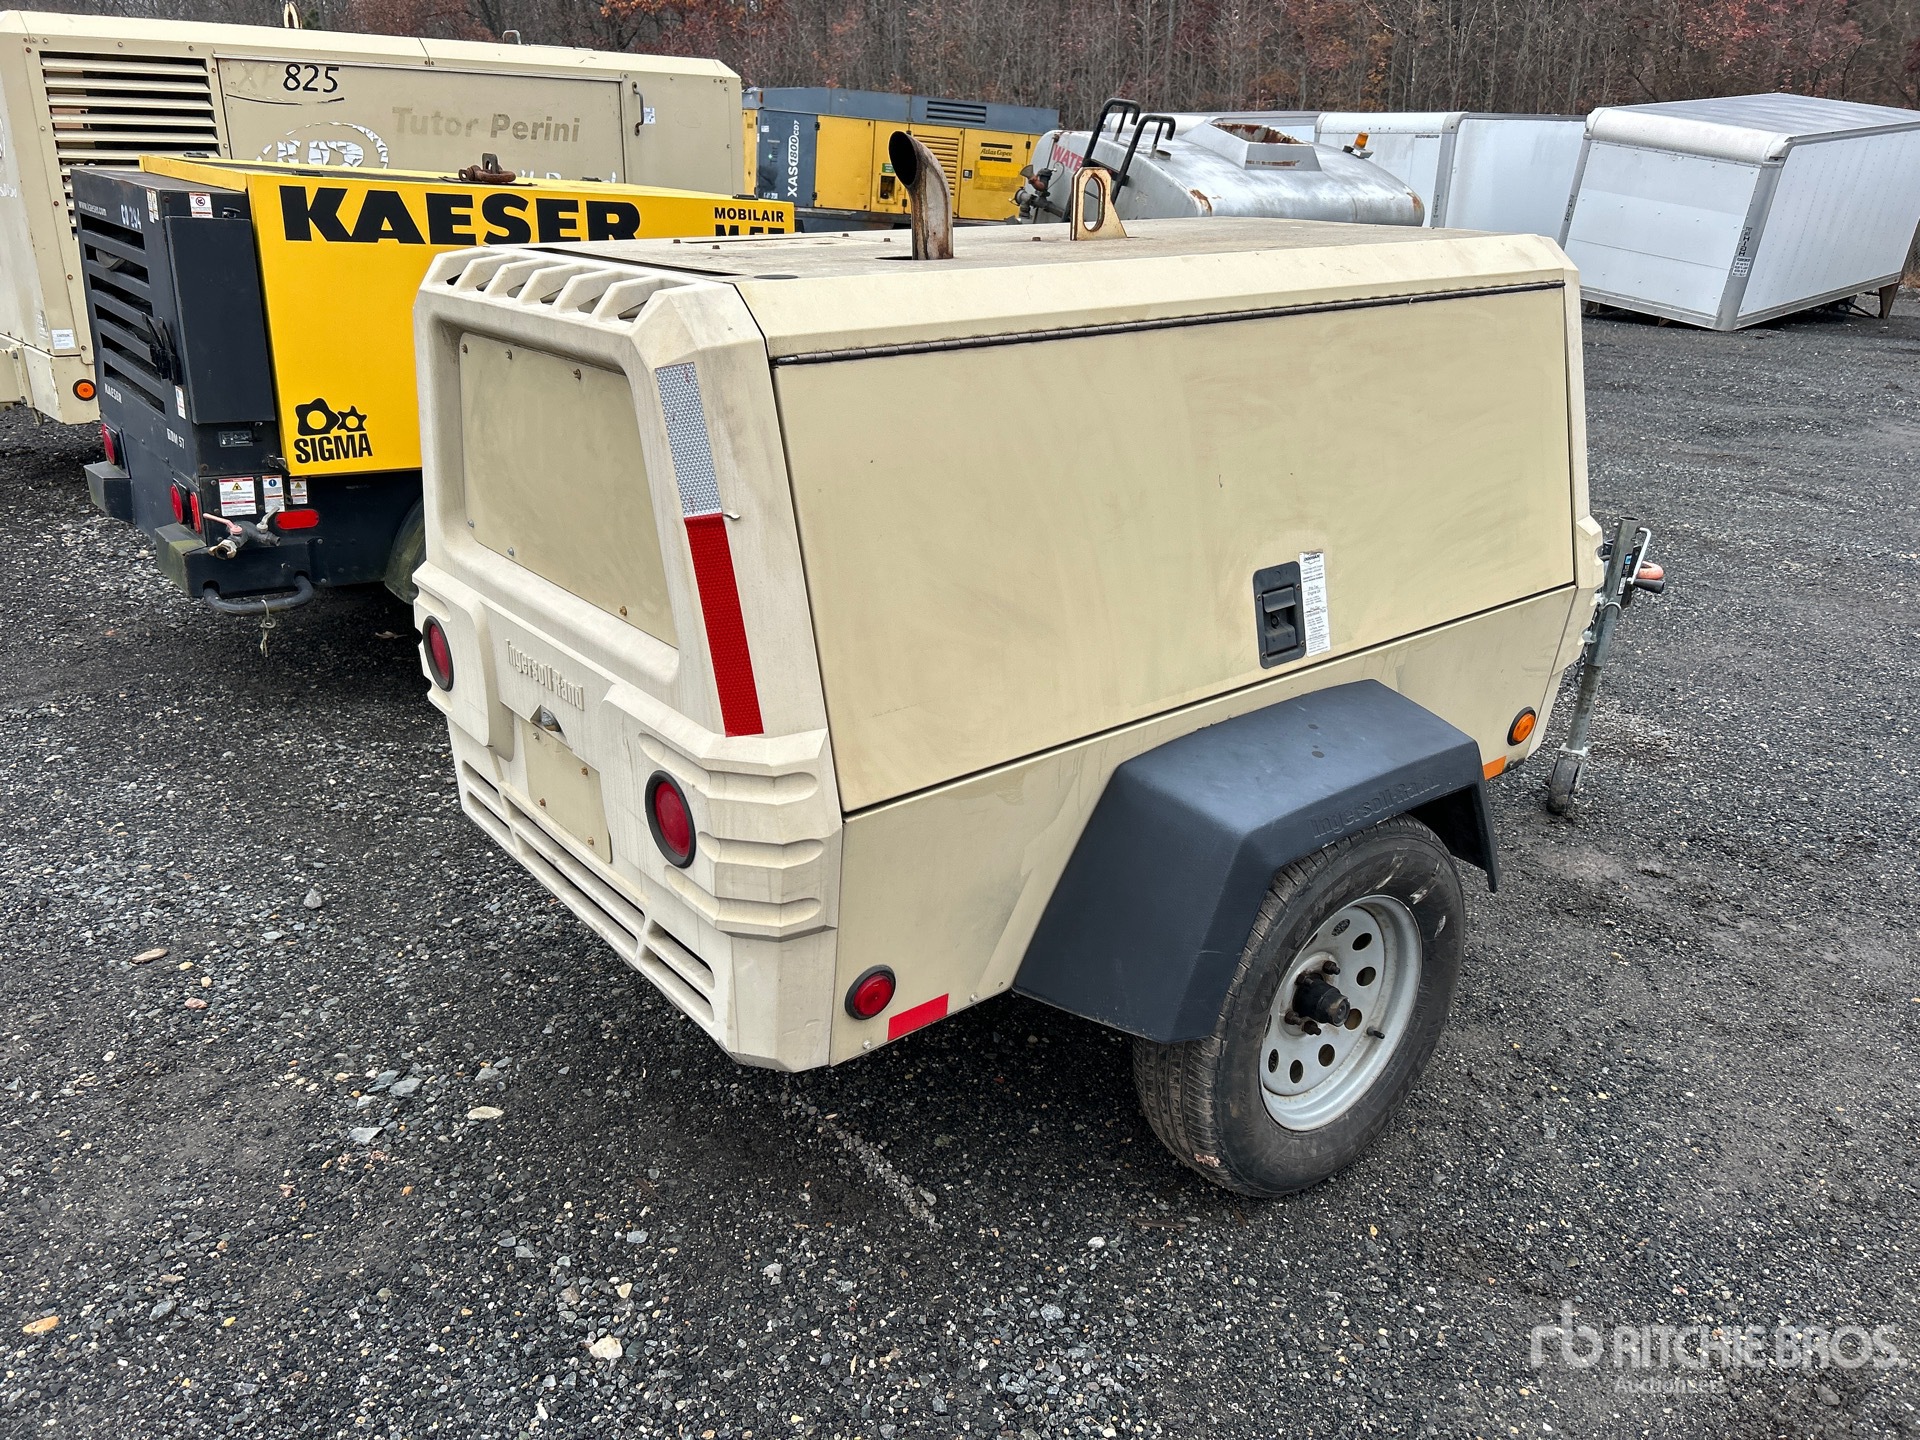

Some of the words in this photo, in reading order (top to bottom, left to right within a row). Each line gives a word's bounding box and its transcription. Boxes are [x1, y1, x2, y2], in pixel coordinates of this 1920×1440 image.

[282, 63, 340, 93] 825
[392, 107, 479, 138] Tutor
[490, 113, 580, 142] Perini
[1053, 144, 1084, 172] WATE
[279, 185, 641, 246] KAESER
[714, 206, 785, 223] MOBILAIR
[293, 433, 373, 464] SIGMA
[505, 638, 554, 692] Ingersoll
[552, 669, 585, 712] Rand
